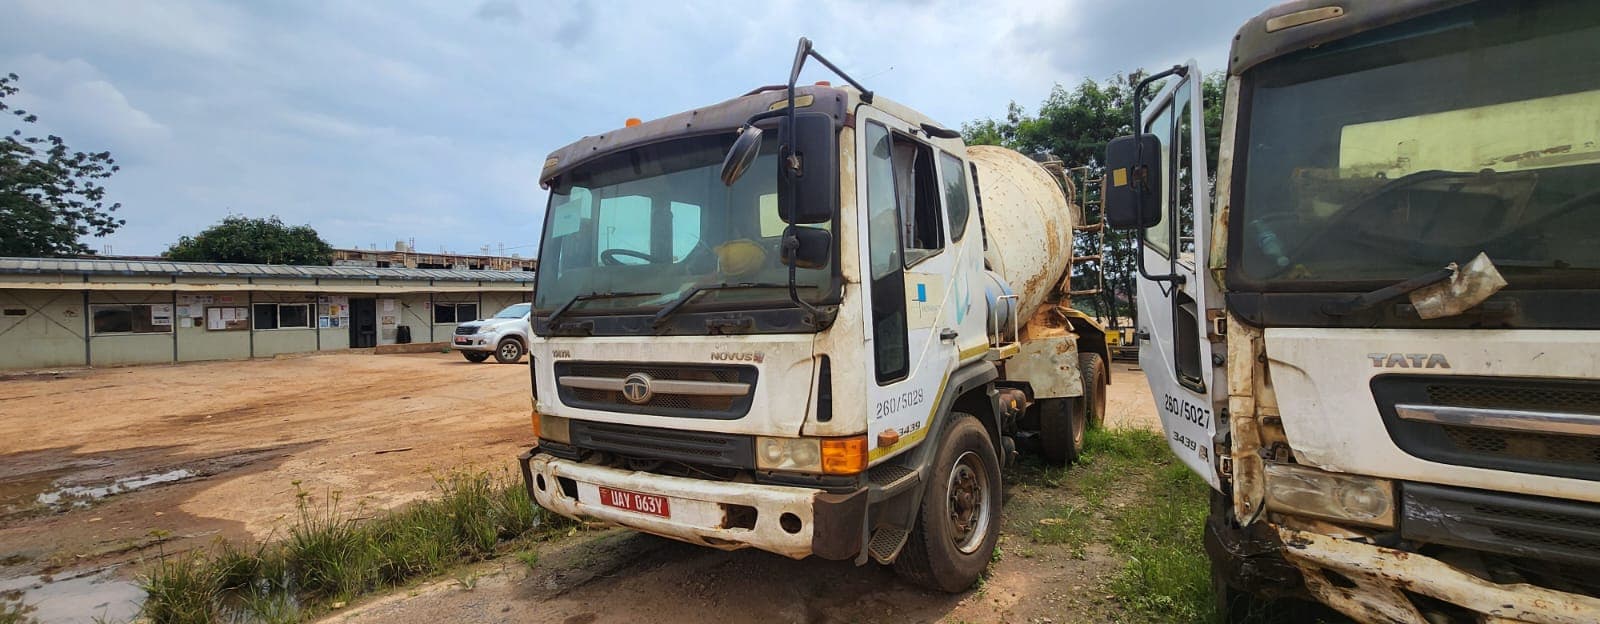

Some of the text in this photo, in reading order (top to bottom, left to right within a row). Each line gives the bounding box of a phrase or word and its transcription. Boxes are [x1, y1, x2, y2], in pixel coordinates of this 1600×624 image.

[711, 351, 753, 361] NOVUS
[1367, 353, 1452, 369] TATA
[876, 388, 924, 419] 260/5029
[1164, 393, 1210, 430] 260/5027
[899, 421, 921, 436] 3439
[1173, 431, 1197, 452] 3439
[611, 489, 662, 514] UAY 063Y
